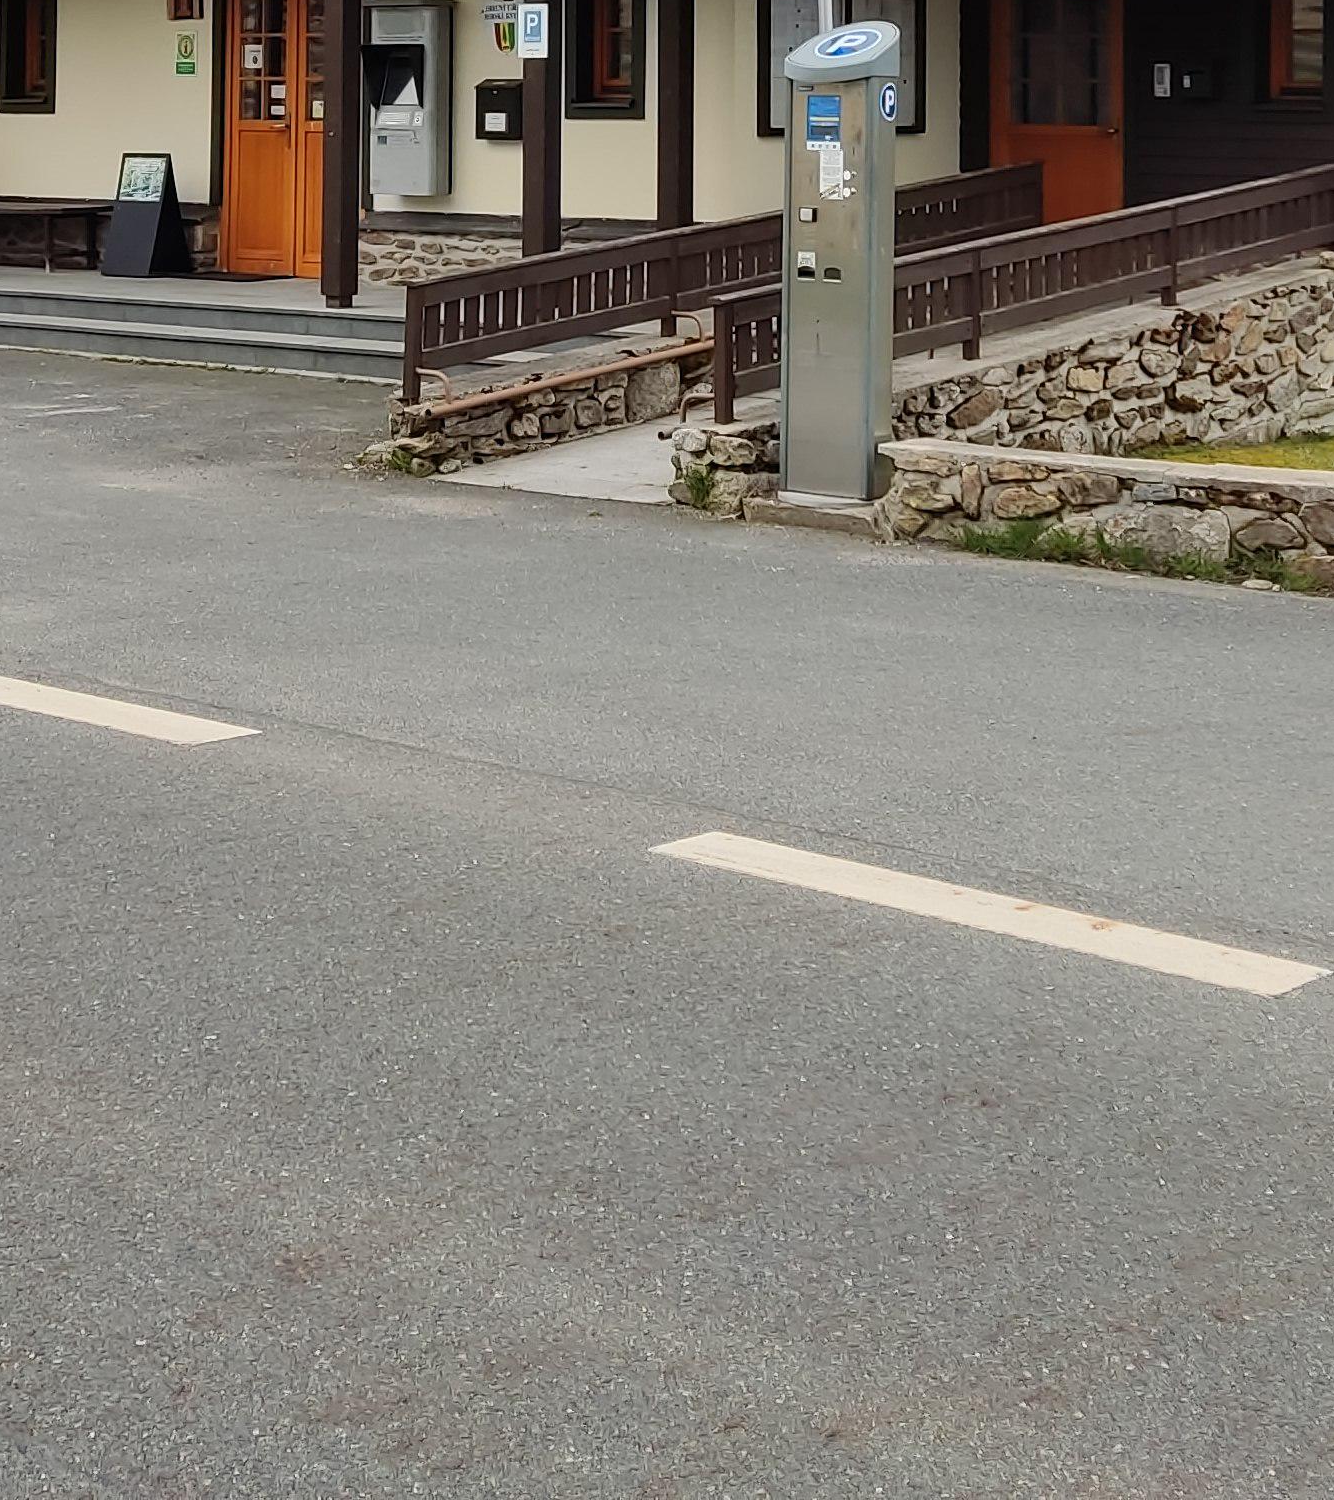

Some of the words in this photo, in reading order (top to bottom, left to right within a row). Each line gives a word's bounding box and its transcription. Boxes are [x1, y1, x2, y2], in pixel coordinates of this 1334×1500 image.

[526, 13, 539, 36] P
[825, 34, 867, 53] P
[884, 89, 895, 114] P
